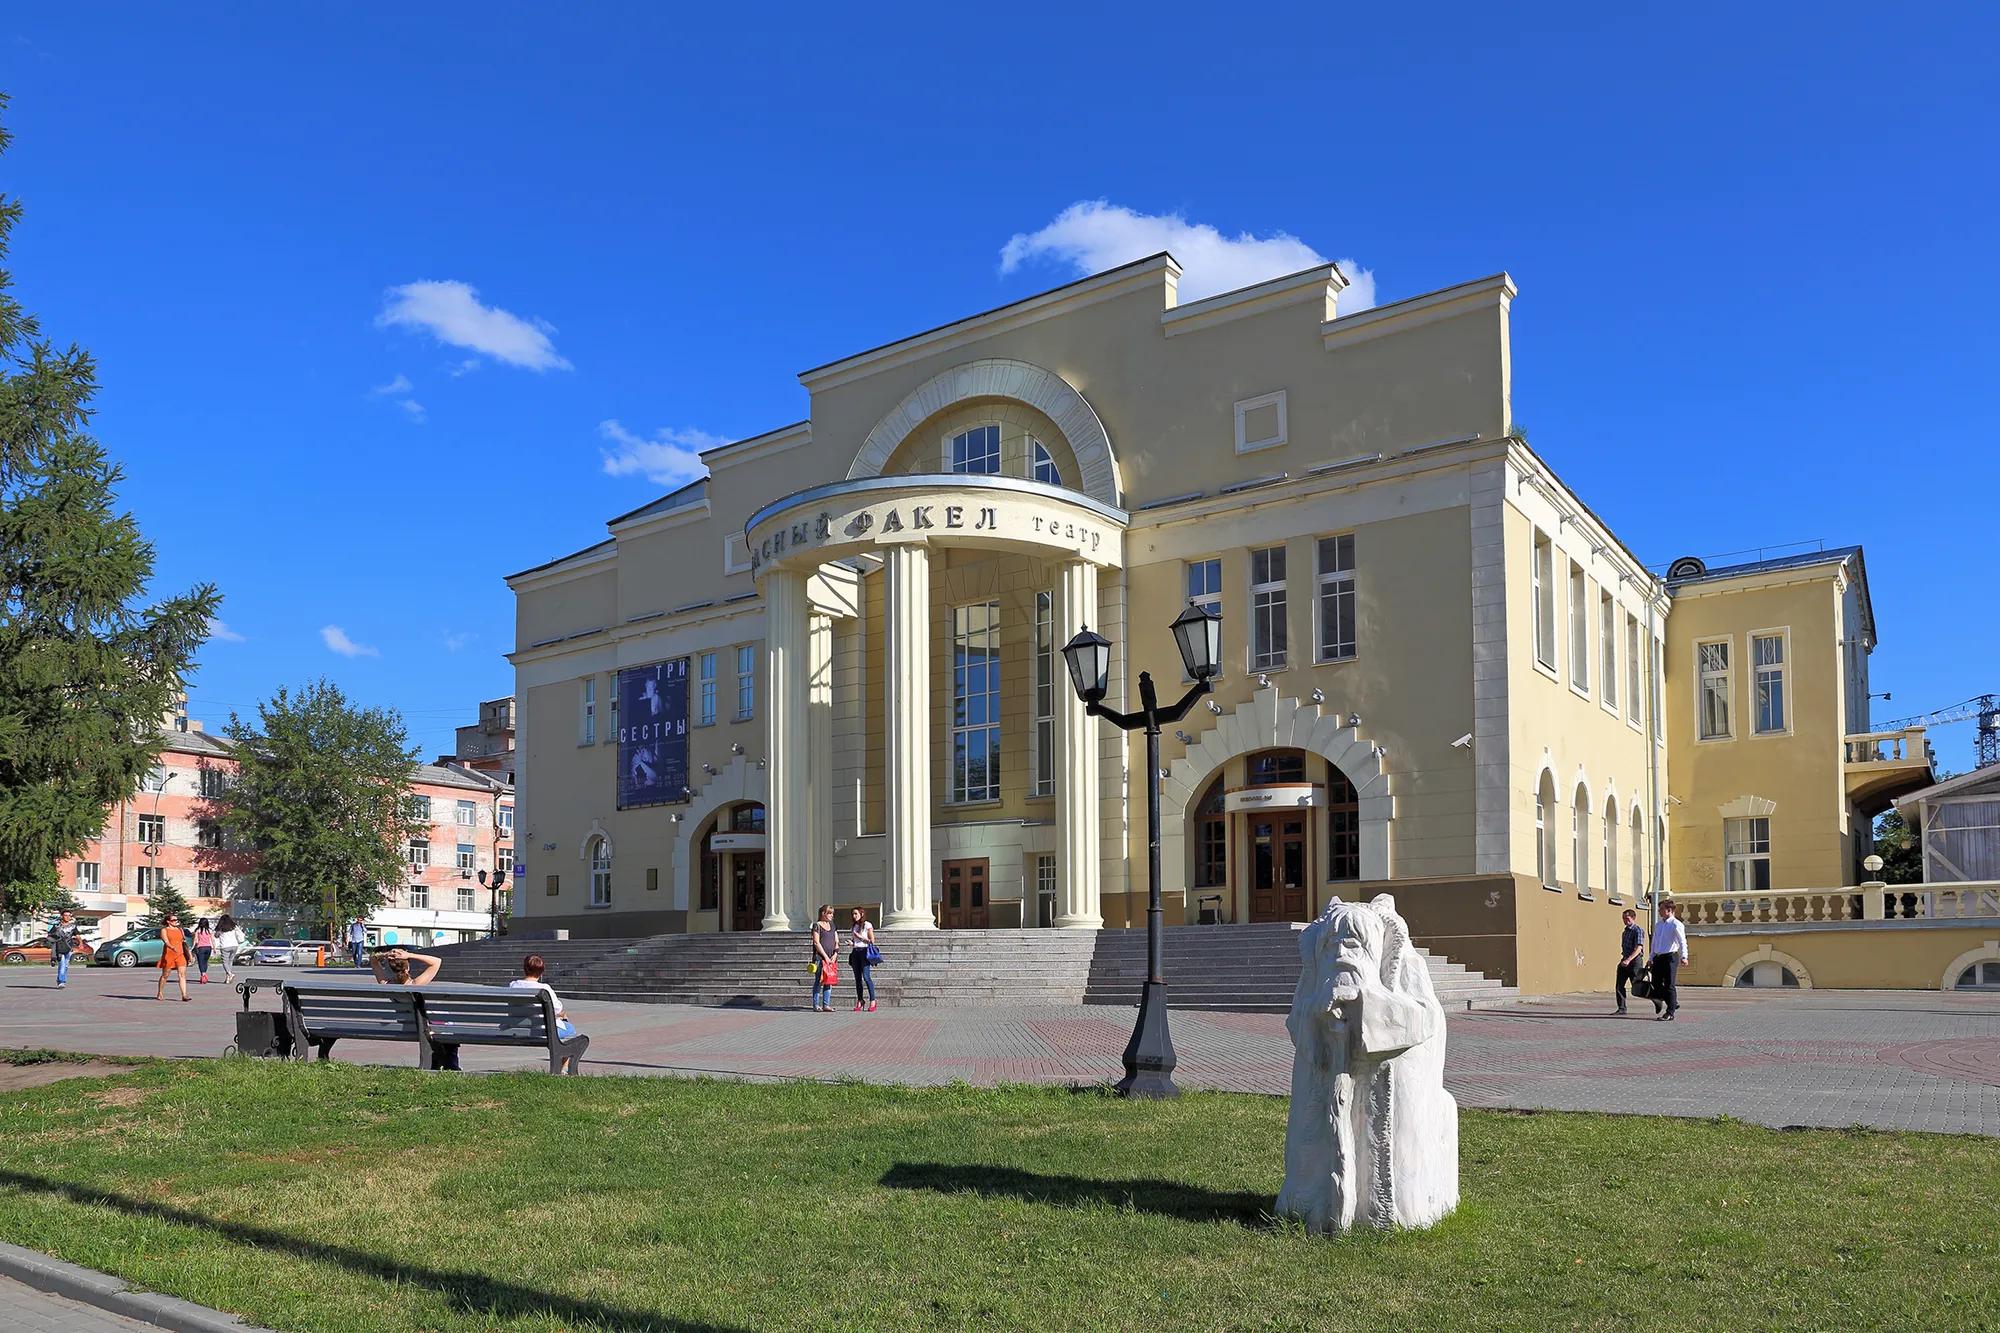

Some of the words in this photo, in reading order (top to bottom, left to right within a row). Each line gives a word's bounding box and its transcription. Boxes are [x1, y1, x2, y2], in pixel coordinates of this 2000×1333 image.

[752, 511, 832, 583] АСНЫЙ
[850, 506, 998, 537] ФАКЕЛ
[1032, 516, 1101, 551] театр
[656, 661, 686, 681] ТРИ
[620, 719, 686, 743] СЕСТРЫ
